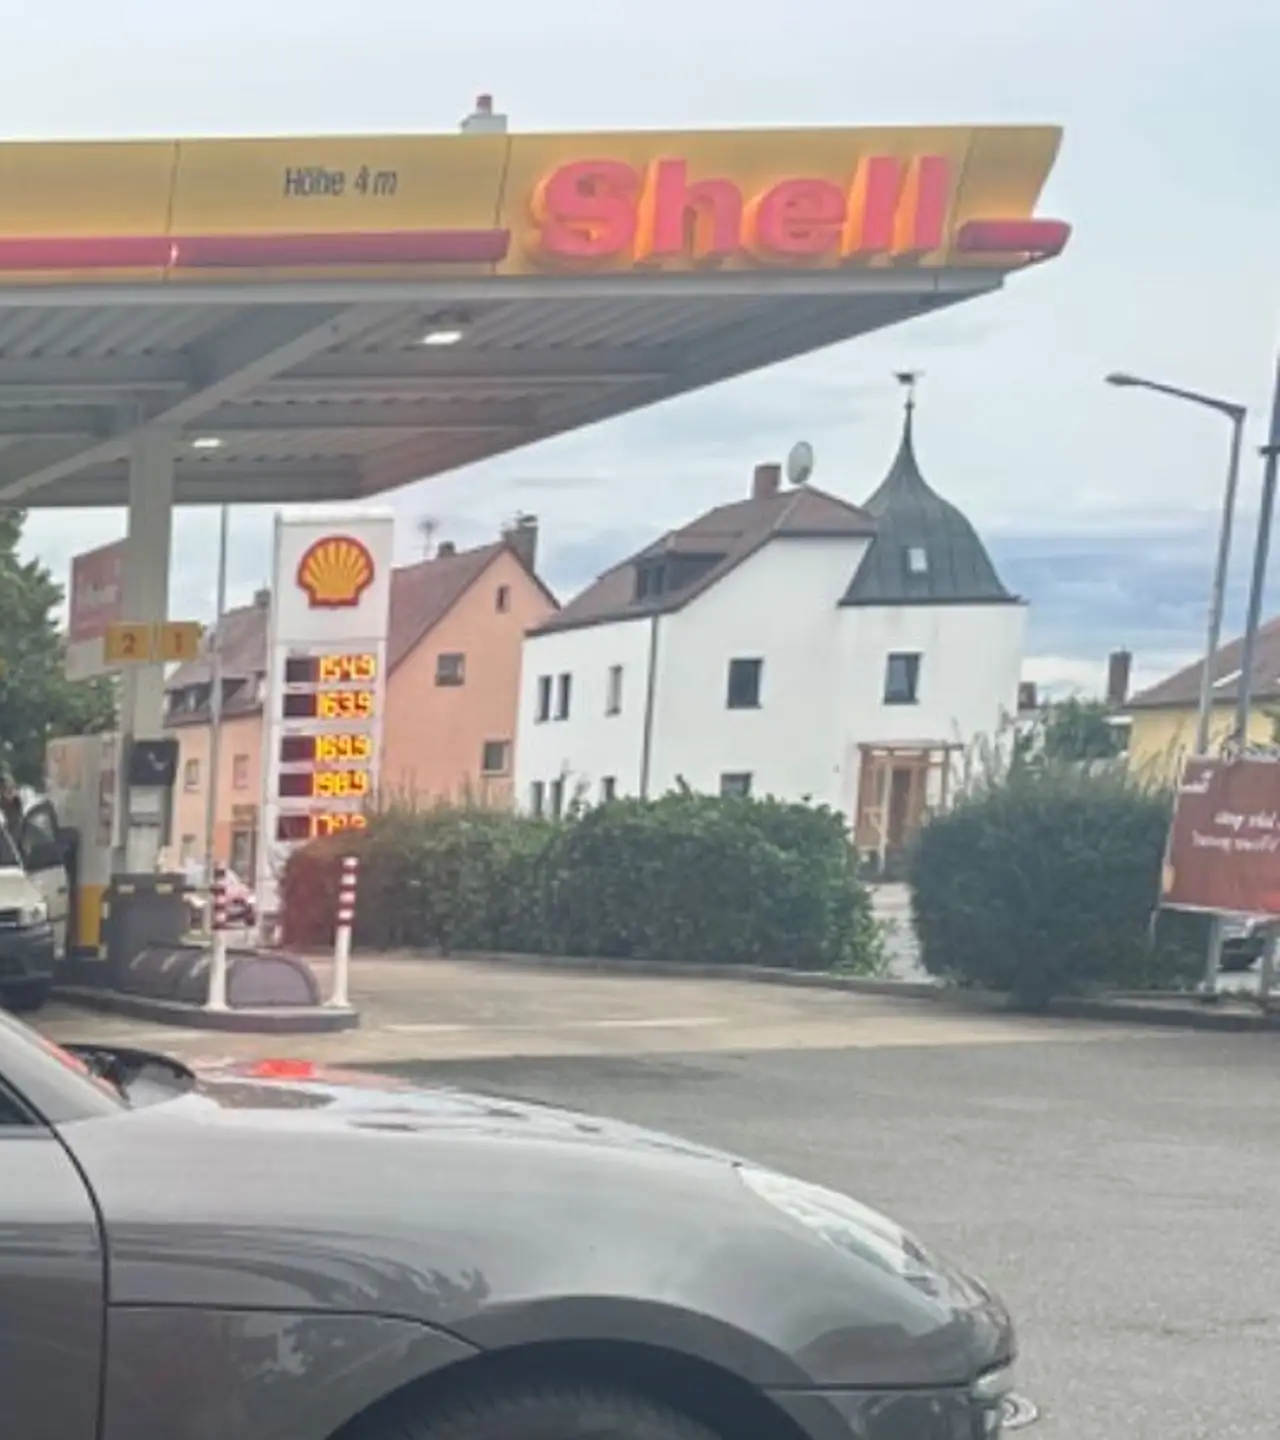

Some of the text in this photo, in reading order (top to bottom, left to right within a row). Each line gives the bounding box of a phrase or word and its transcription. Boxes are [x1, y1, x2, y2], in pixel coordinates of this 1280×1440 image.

[284, 165, 345, 197] Höhe
[537, 155, 948, 260] Shell
[121, 632, 137, 654] 2
